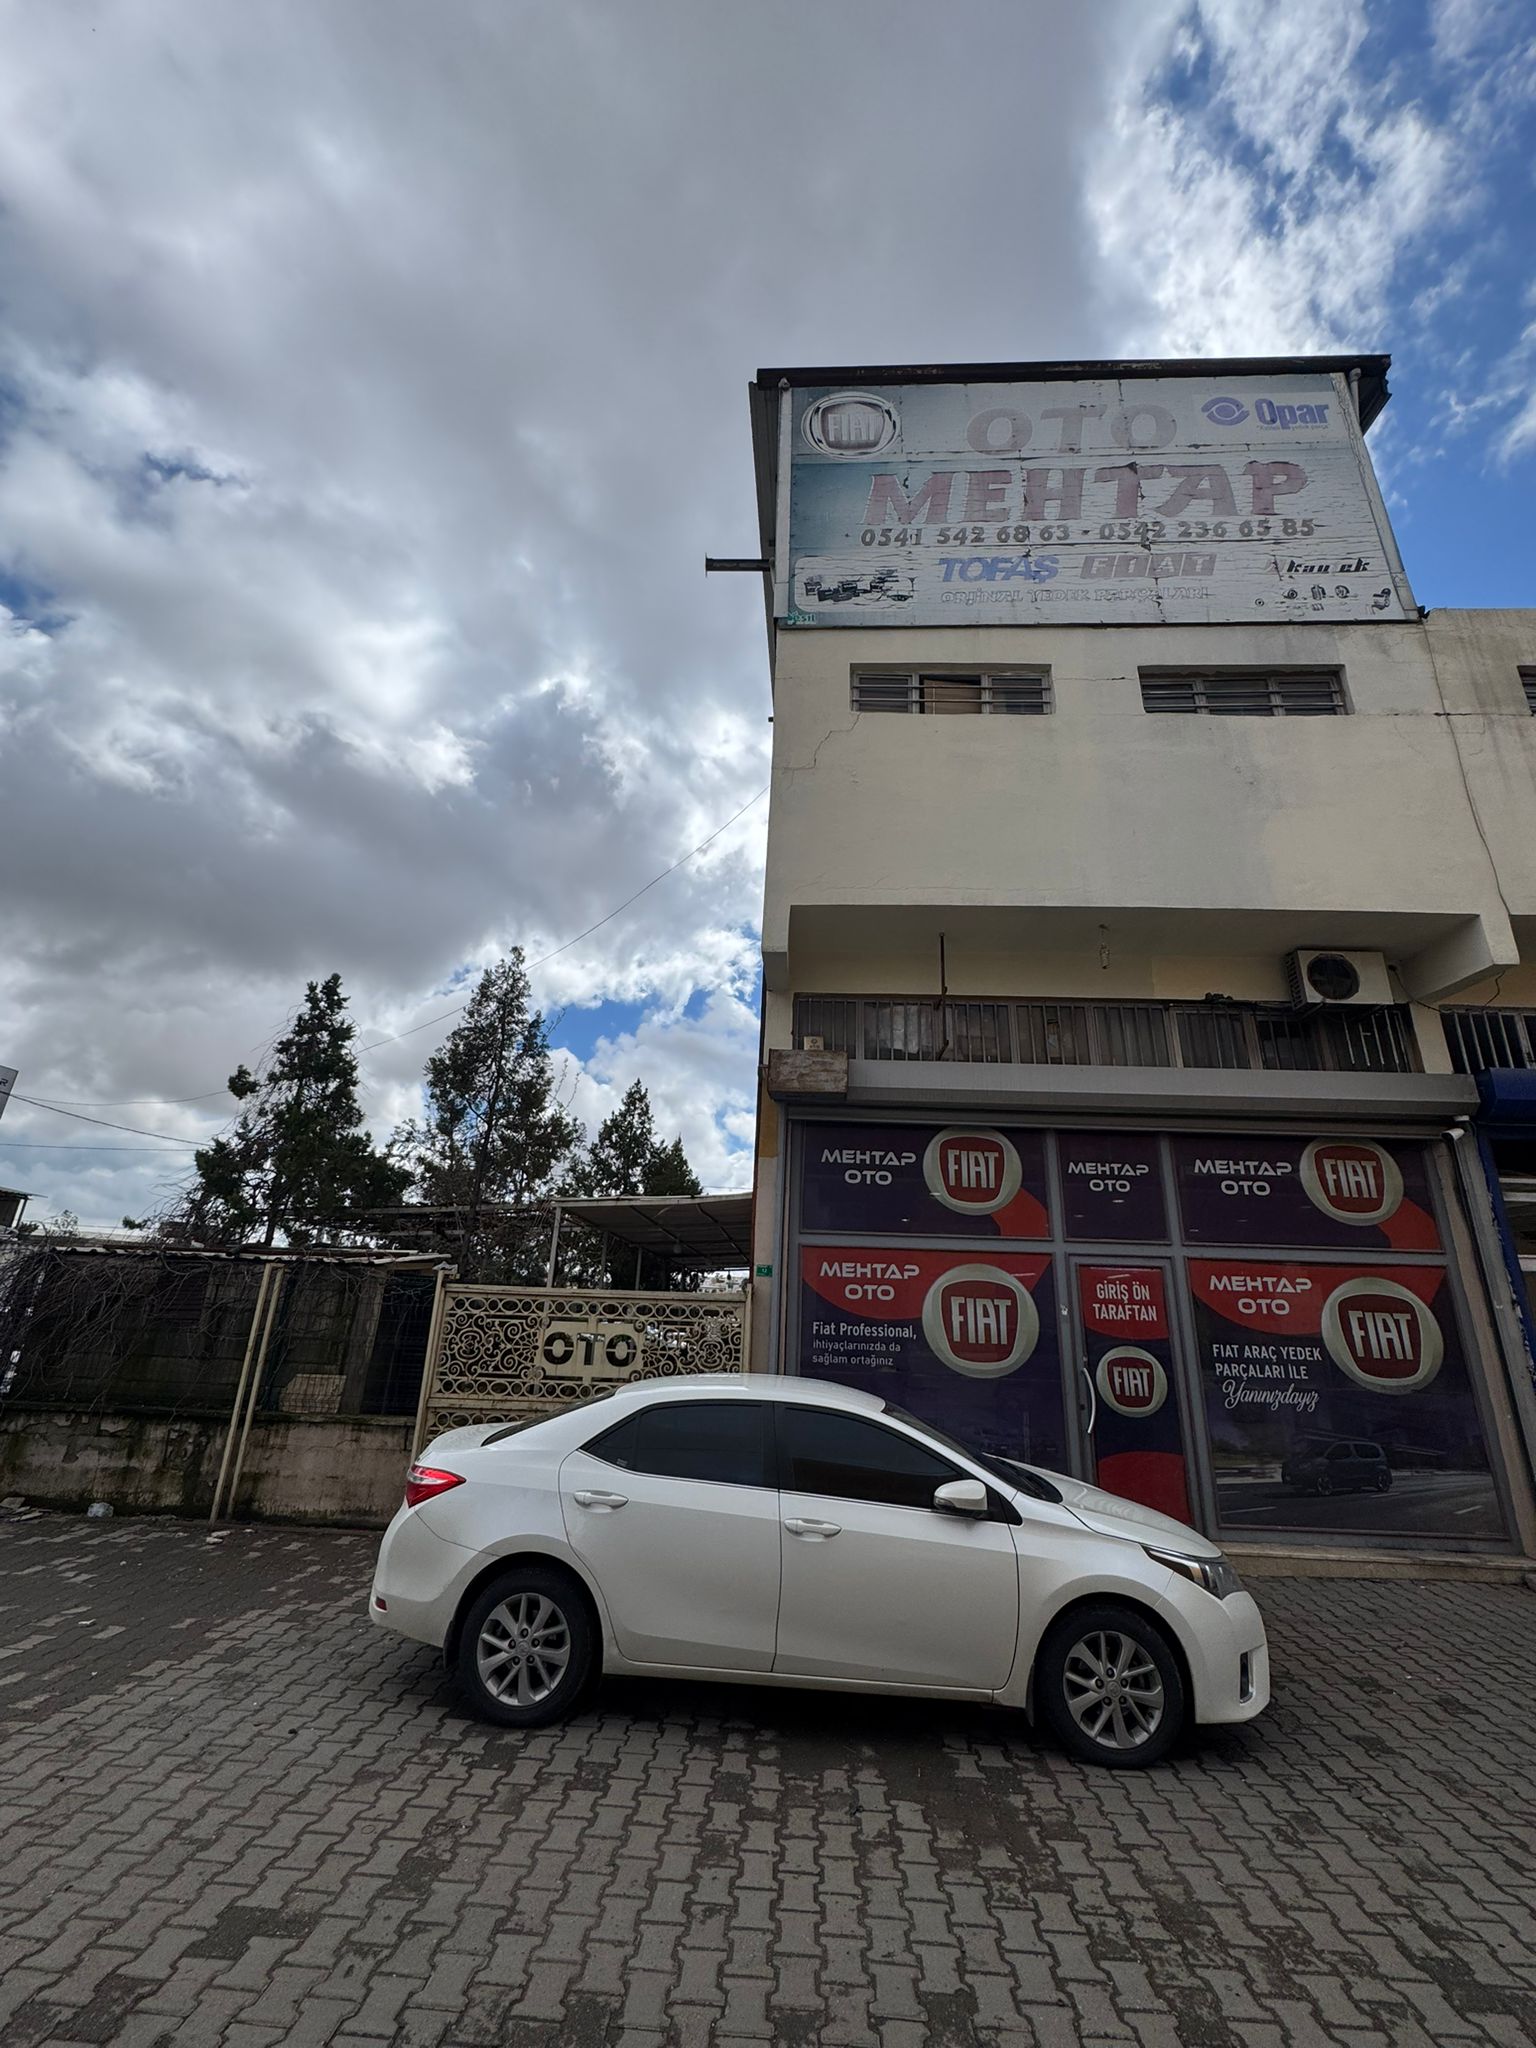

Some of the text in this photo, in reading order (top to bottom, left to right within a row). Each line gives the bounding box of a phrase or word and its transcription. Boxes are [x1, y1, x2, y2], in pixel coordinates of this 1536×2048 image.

[1255, 398, 1329, 430] Opar
[827, 413, 883, 441] FIAT
[966, 404, 1177, 455] OTO
[861, 460, 1309, 525] MEHTAP
[861, 525, 922, 547] 0541
[936, 525, 985, 545] 542
[995, 525, 1030, 543] 68
[1039, 524, 1071, 542] 63
[1100, 521, 1166, 540] 0542
[1178, 520, 1227, 538] 236
[1239, 519, 1271, 537] 65
[1282, 518, 1315, 536] 85
[938, 554, 1060, 584] TOFAŞ
[1086, 554, 1213, 577] FIAT
[820, 1148, 917, 1166] MEHTAP
[844, 1169, 893, 1186] OTO
[947, 1149, 999, 1188] FIAT
[1068, 1161, 1149, 1176] MEHTAP
[1194, 1159, 1292, 1177] MEHTAP
[1089, 1179, 1131, 1193] OTO
[1220, 1180, 1271, 1196] OTO
[1322, 1158, 1377, 1199] FIAT
[819, 1261, 920, 1279] MEHTAP
[844, 1284, 895, 1300] OTO
[1096, 1280, 1150, 1303] GİRİŞ ÖN
[1209, 1275, 1312, 1293] MEHTAP
[1092, 1303, 1157, 1322] TARAFTAN
[1237, 1298, 1290, 1315] OTO
[950, 1296, 1012, 1345] FIAT
[812, 1321, 917, 1340] Fiat Professional,
[1348, 1310, 1414, 1361] FIAT
[543, 1331, 637, 1367] OTO
[812, 1338, 901, 1352] ihtiyaçlarınızda da
[1212, 1344, 1323, 1362] FIAT ARAÇ YEDEK
[812, 1353, 894, 1367] sağlam ortağınız
[1215, 1363, 1309, 1380] PARÇALARI İLE
[1112, 1366, 1151, 1397] FIAT
[1222, 1379, 1320, 1413] Yanınızdayız
